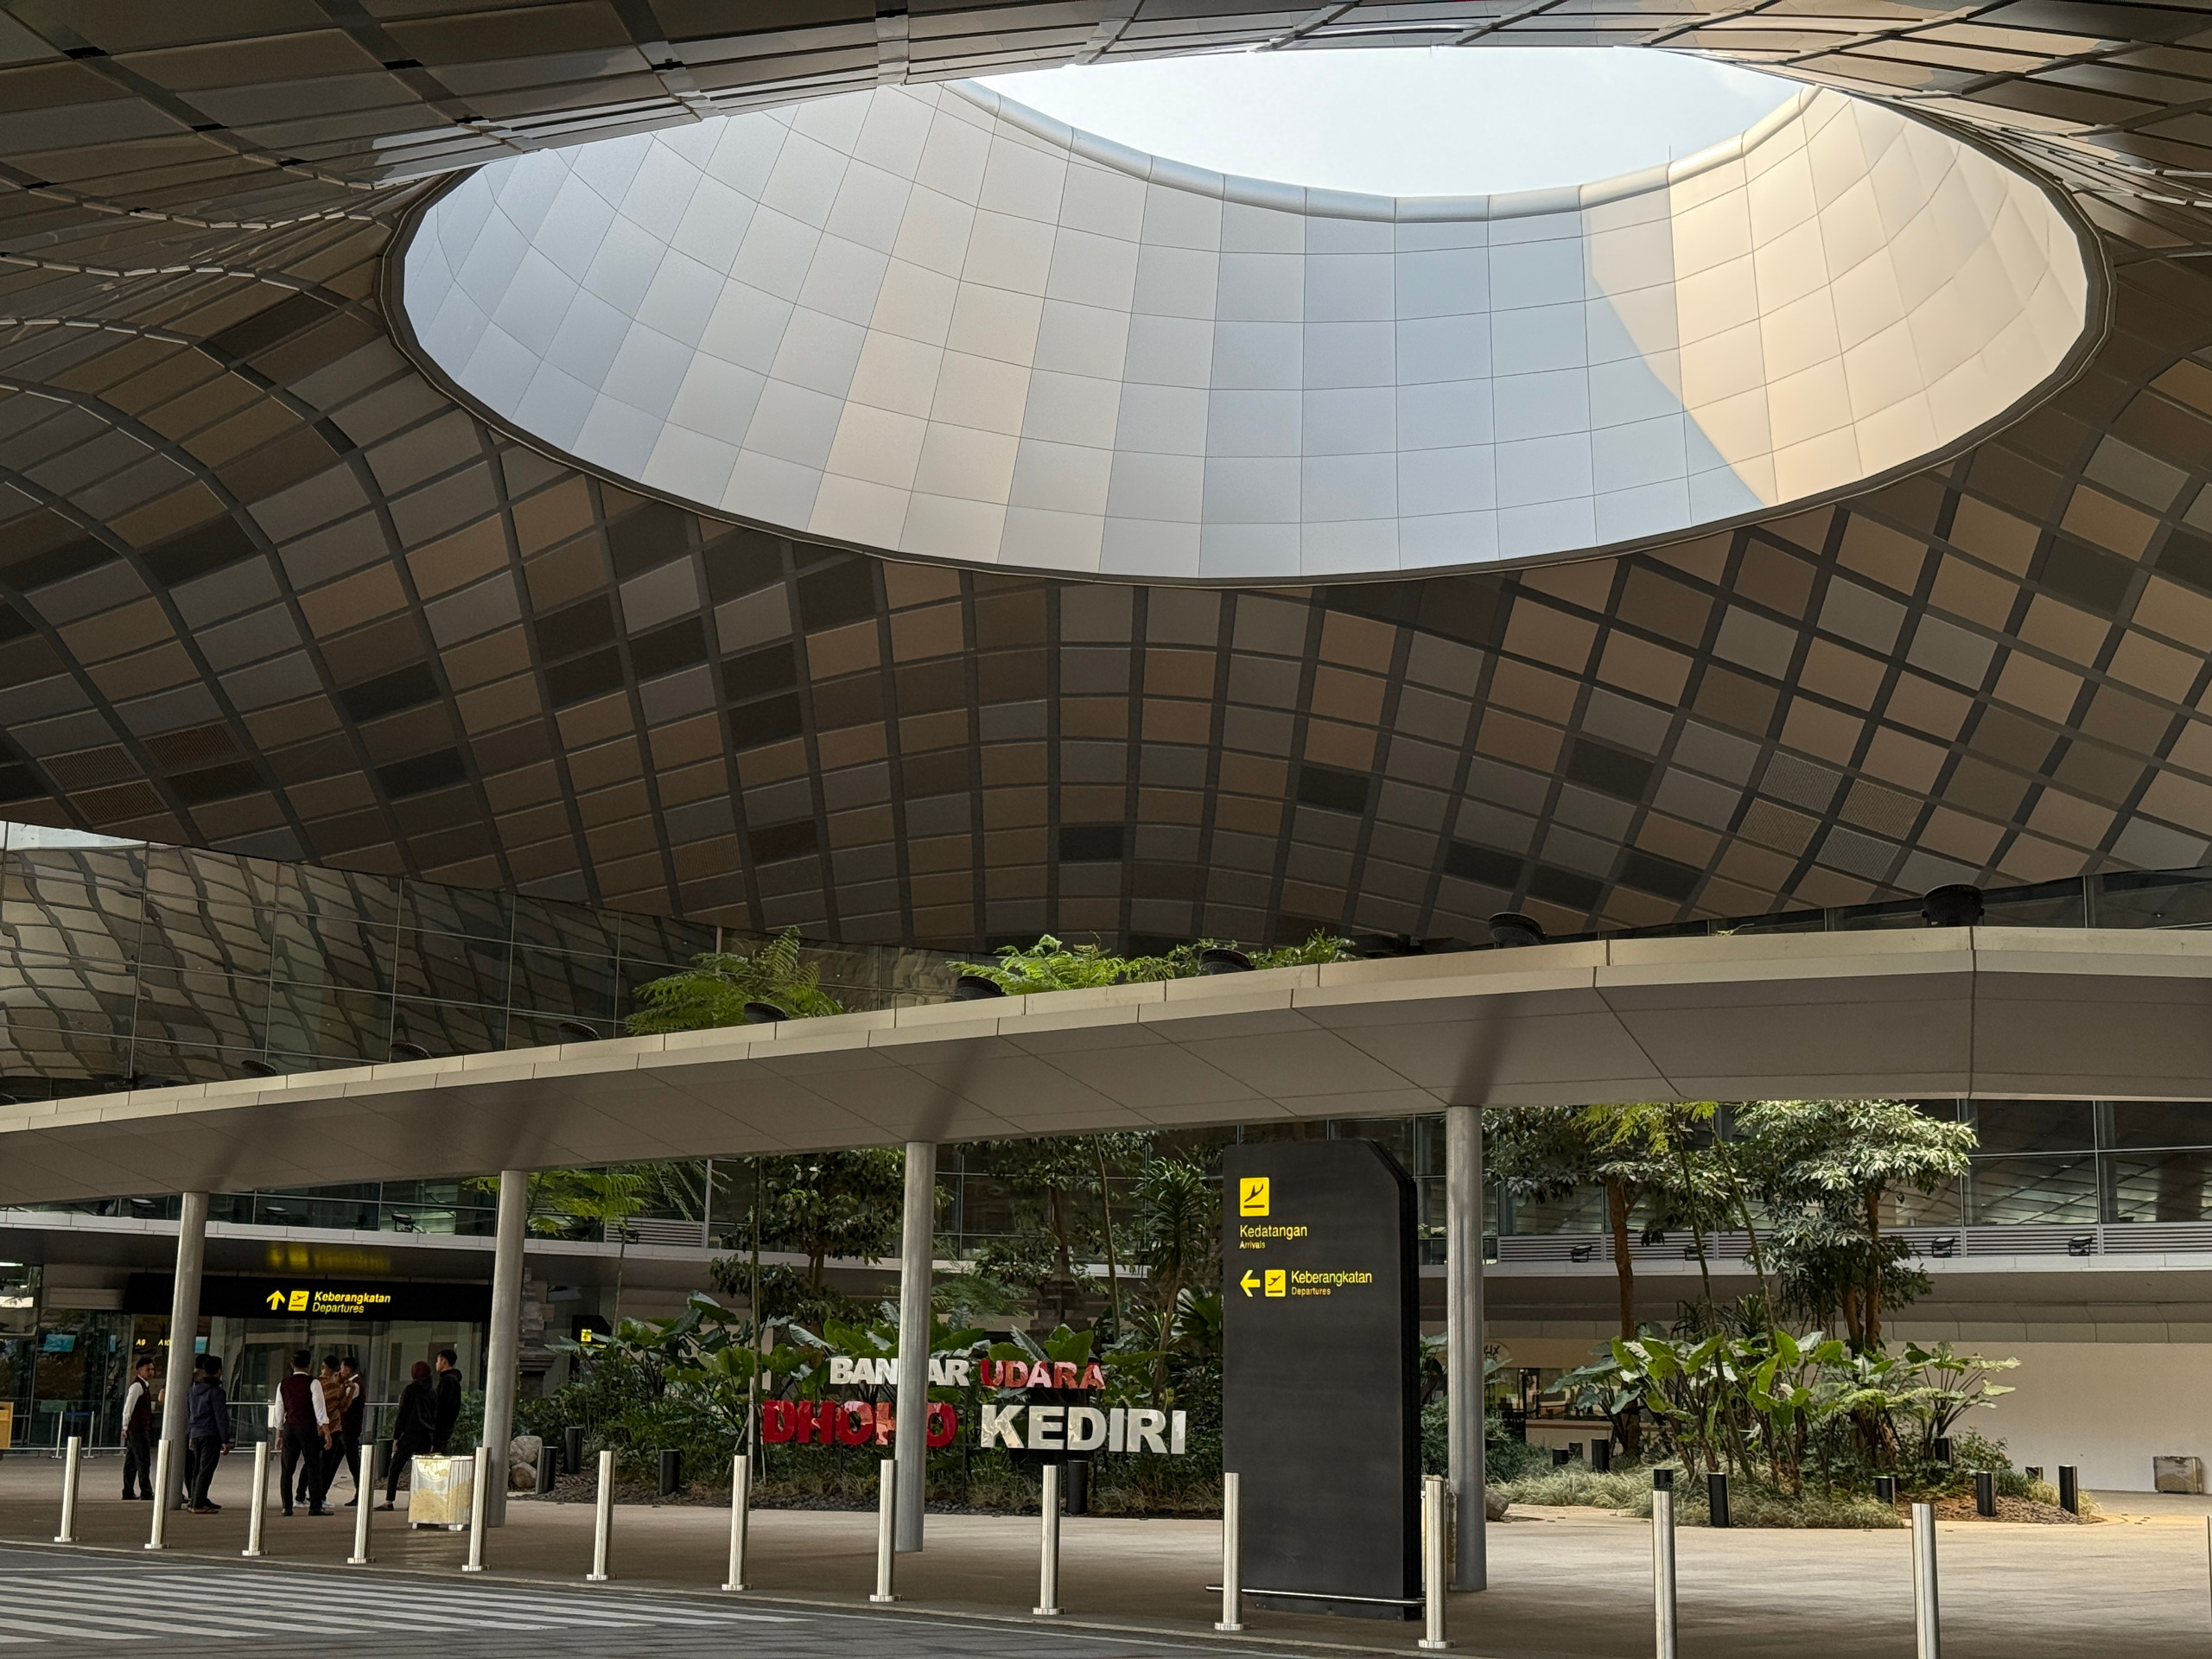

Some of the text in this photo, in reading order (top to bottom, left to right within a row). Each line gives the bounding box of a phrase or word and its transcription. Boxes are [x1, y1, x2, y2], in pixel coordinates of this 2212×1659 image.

[1239, 1224, 1307, 1240] Kedatangan
[1239, 1240, 1266, 1249] Arrivals
[1291, 1270, 1373, 1287] Keberangkatan
[314, 1291, 391, 1305] Keberangkatan
[1291, 1287, 1332, 1296] Departures
[312, 1301, 365, 1314] Departures
[830, 1357, 1106, 1390] BANAR UDARA
[980, 1404, 1187, 1454] KEDIRI
